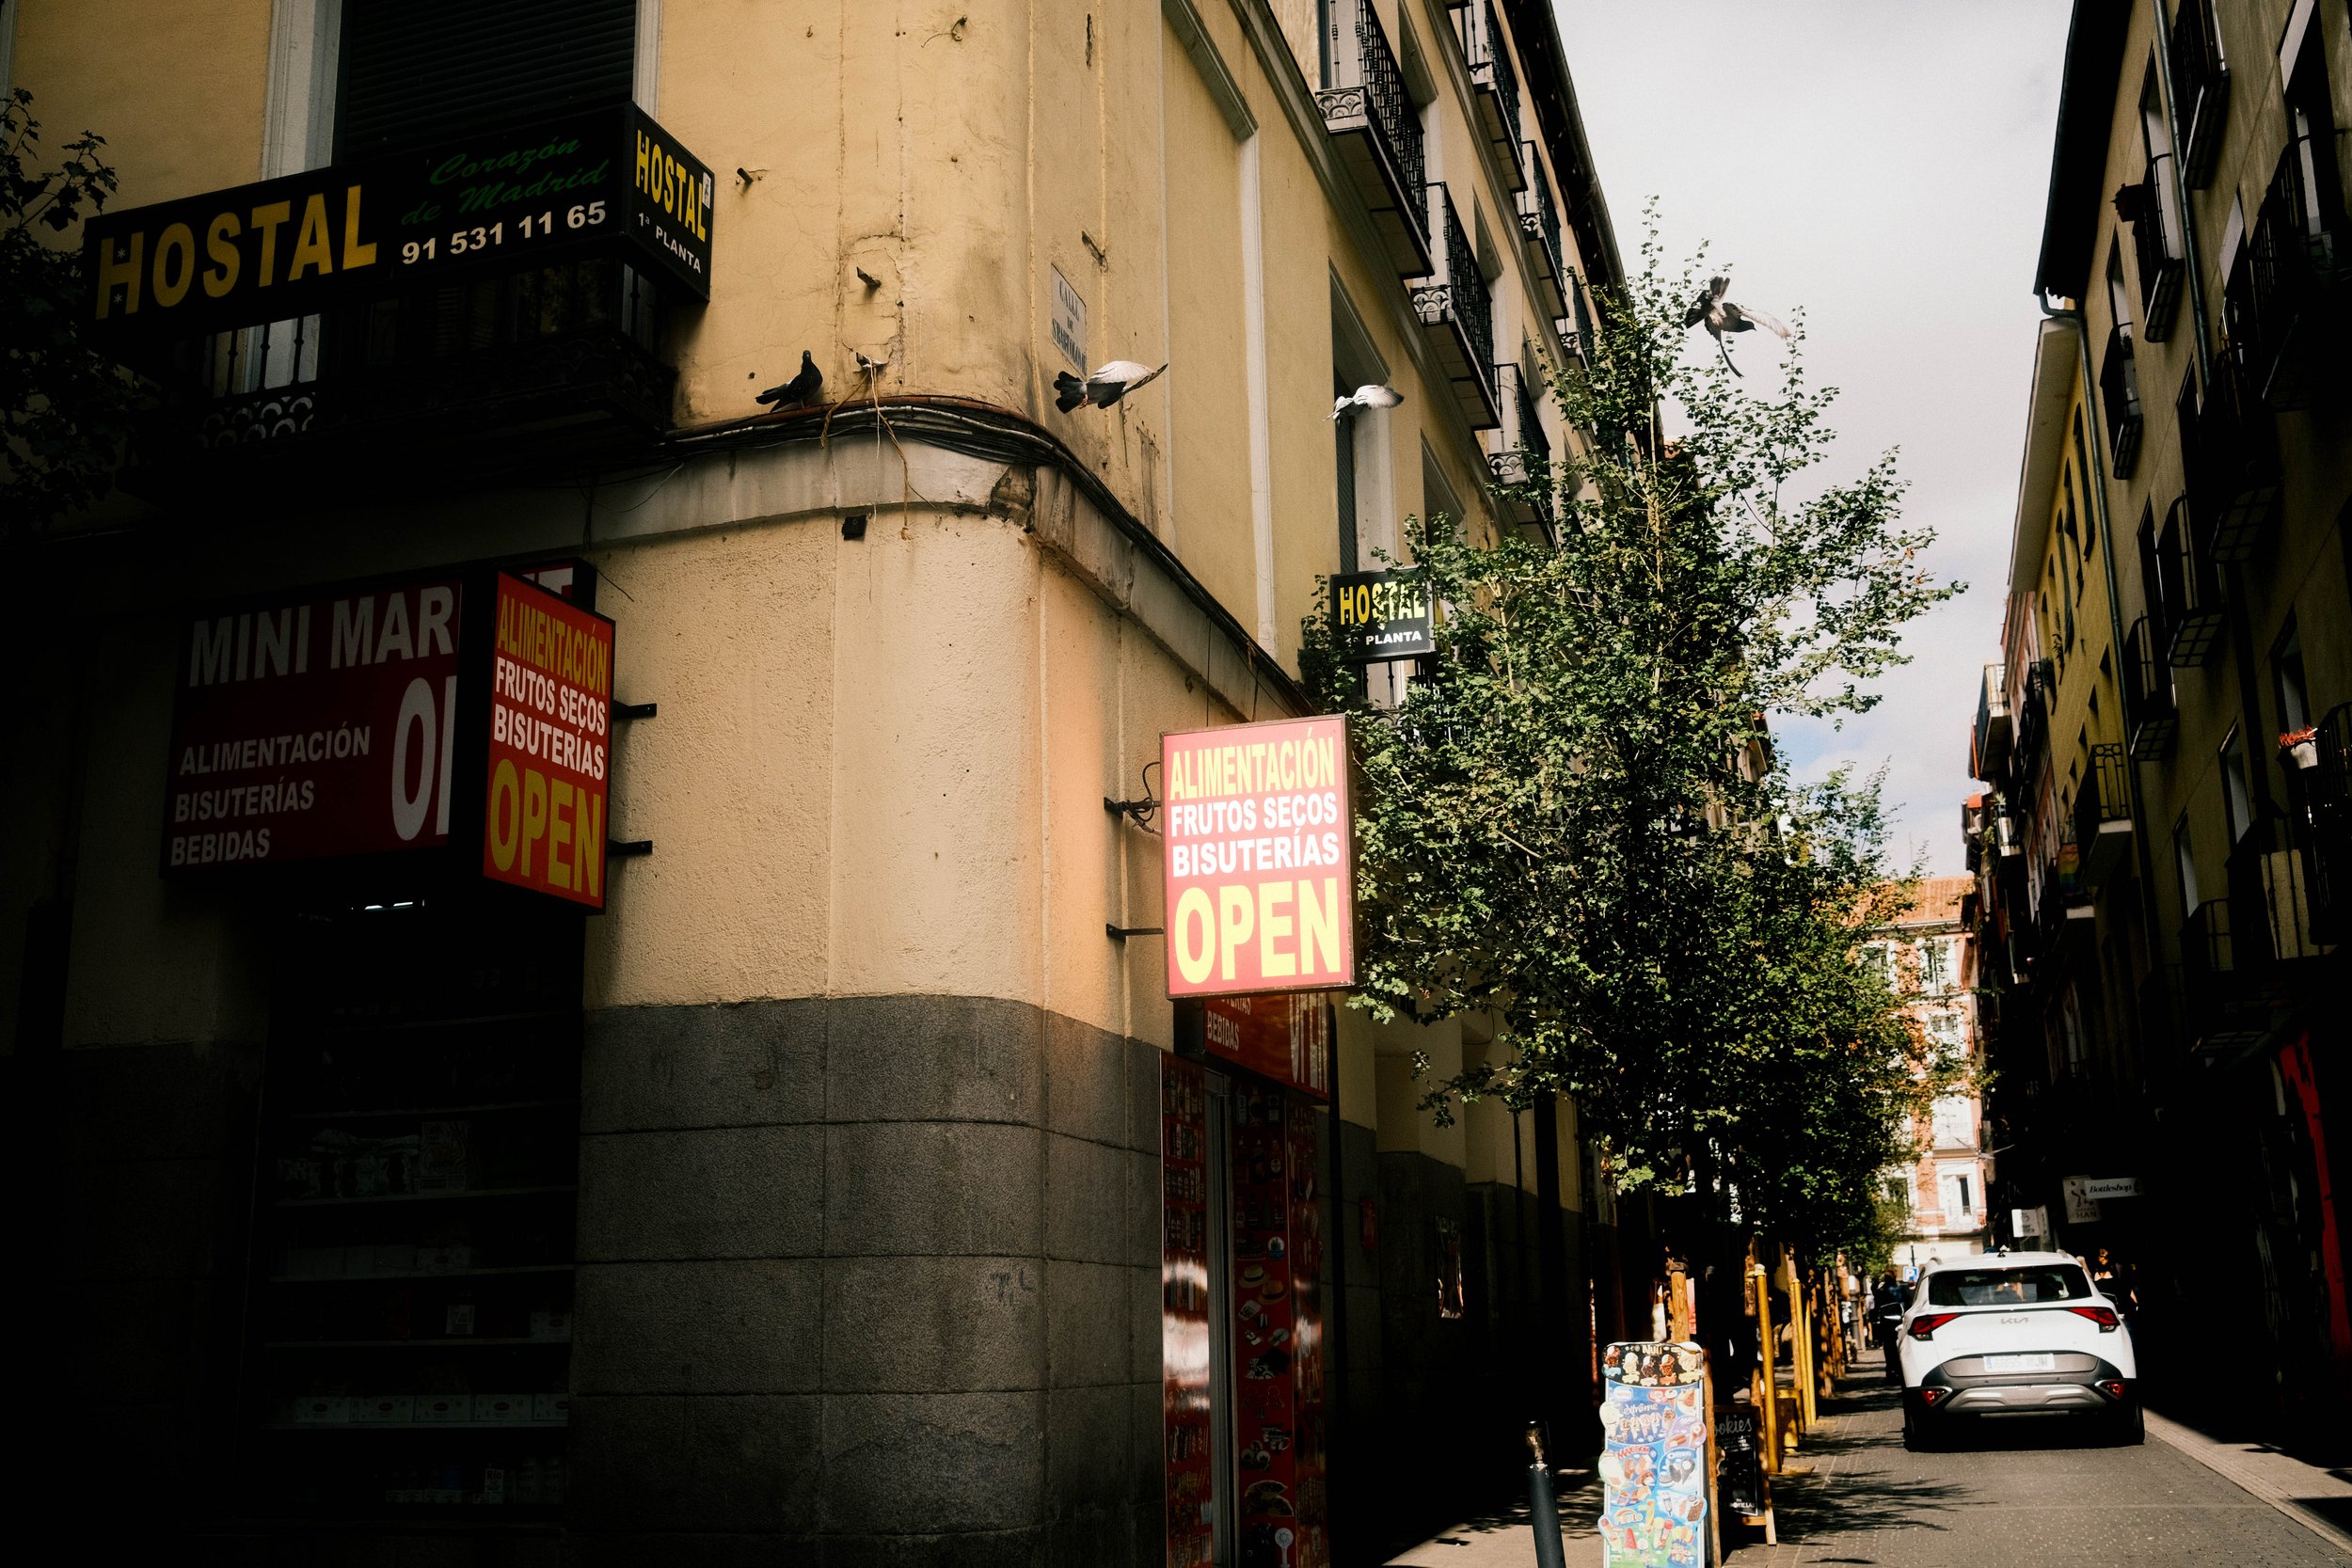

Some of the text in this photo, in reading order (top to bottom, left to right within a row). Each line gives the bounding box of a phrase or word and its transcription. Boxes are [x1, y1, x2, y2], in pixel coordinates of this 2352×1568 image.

[401, 158, 611, 226] de Madrid
[429, 135, 582, 186] Corazón
[635, 129, 707, 243] HOSTAL
[94, 184, 378, 321] HOSTAL
[401, 199, 607, 265] 91 531 11 65
[655, 225, 702, 274] PLANTA
[1340, 580, 1425, 626] HOSTAL
[188, 604, 311, 688] MINI
[497, 594, 608, 696] ALIMENTACIÓN
[1365, 630, 1422, 646] PLANTA
[495, 657, 606, 737] FRUTOS SECOS
[180, 721, 371, 776] ALIMENTACIÓN
[493, 703, 605, 782] BISUTERÍAS
[1169, 726, 1335, 800] ALIMENTACIÓN
[174, 779, 315, 824] BISUTERÍAS
[489, 757, 601, 897] OPEN
[1170, 791, 1338, 838] FRUTOS SECOS
[170, 828, 271, 867] BEBIDAS
[1172, 827, 1340, 878] BISUTERÍAS
[1174, 879, 1343, 984] OPEN
[1207, 1010, 1240, 1052] BEBIDAS
